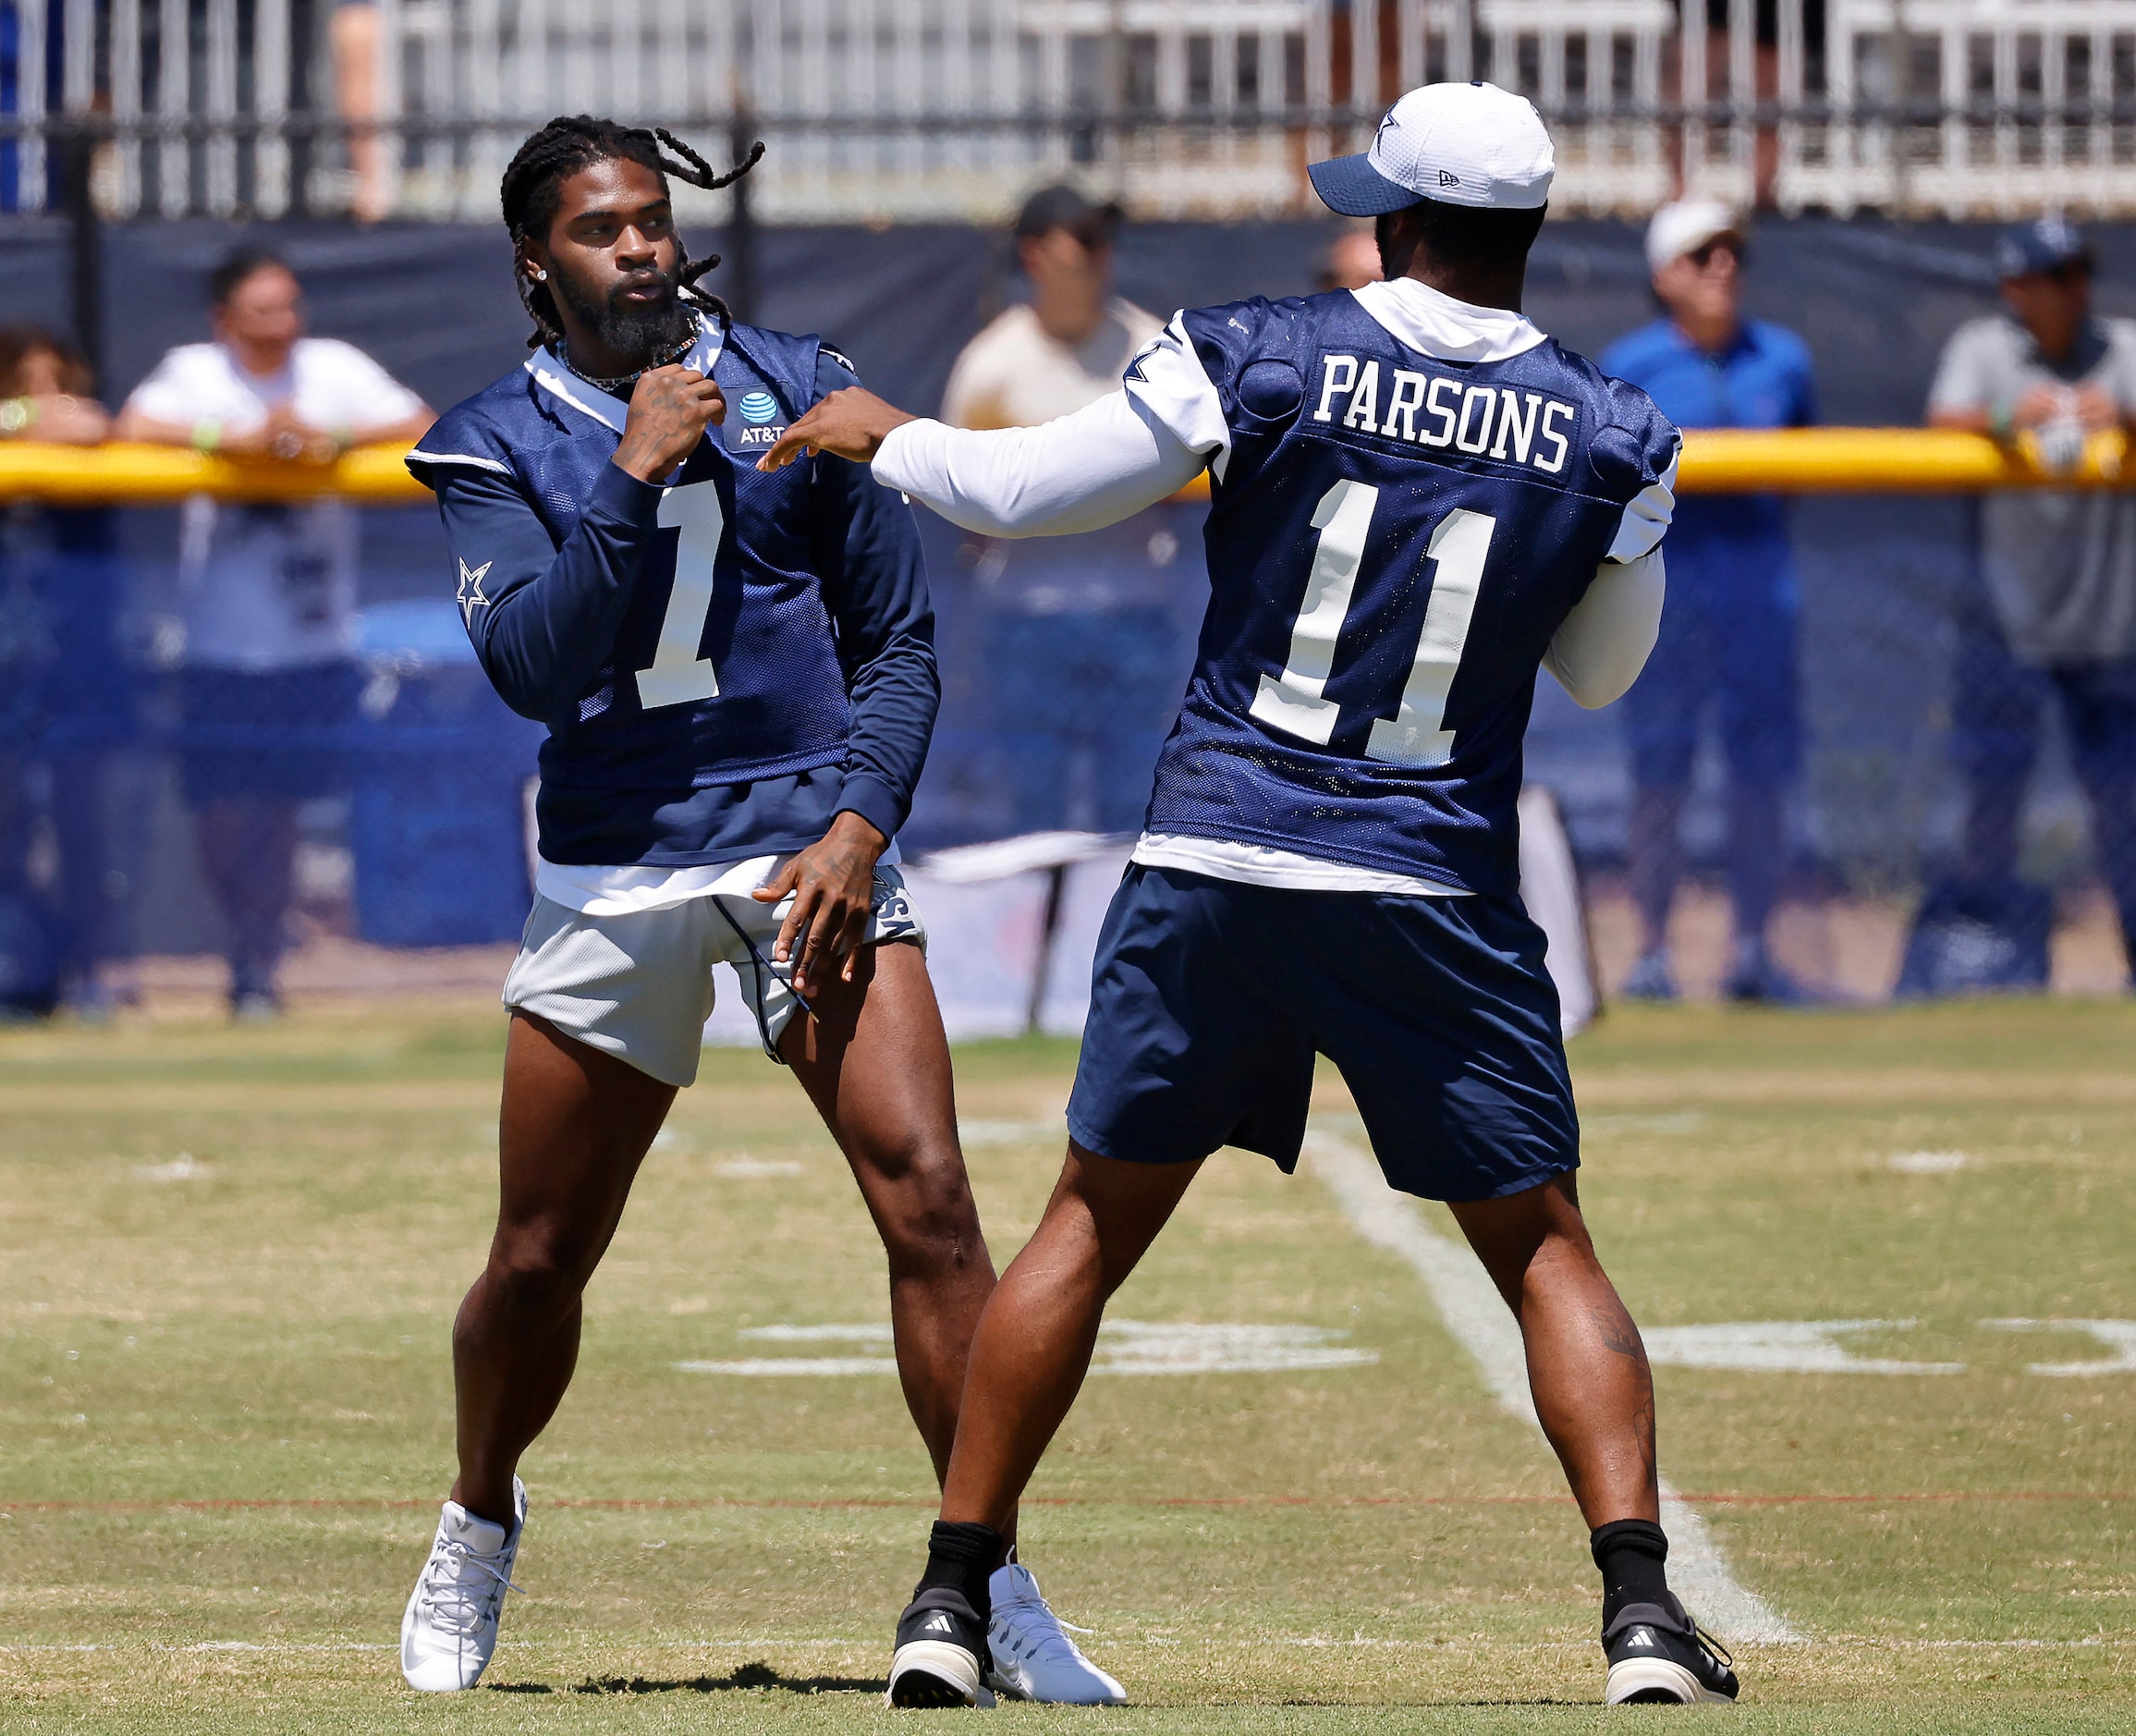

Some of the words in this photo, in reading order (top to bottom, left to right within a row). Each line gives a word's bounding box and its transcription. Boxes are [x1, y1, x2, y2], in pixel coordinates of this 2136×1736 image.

[740, 426, 786, 445] AT&T
[1313, 354, 1574, 473] PARSONS
[635, 479, 724, 709] 1
[1249, 478, 1496, 765] 11
